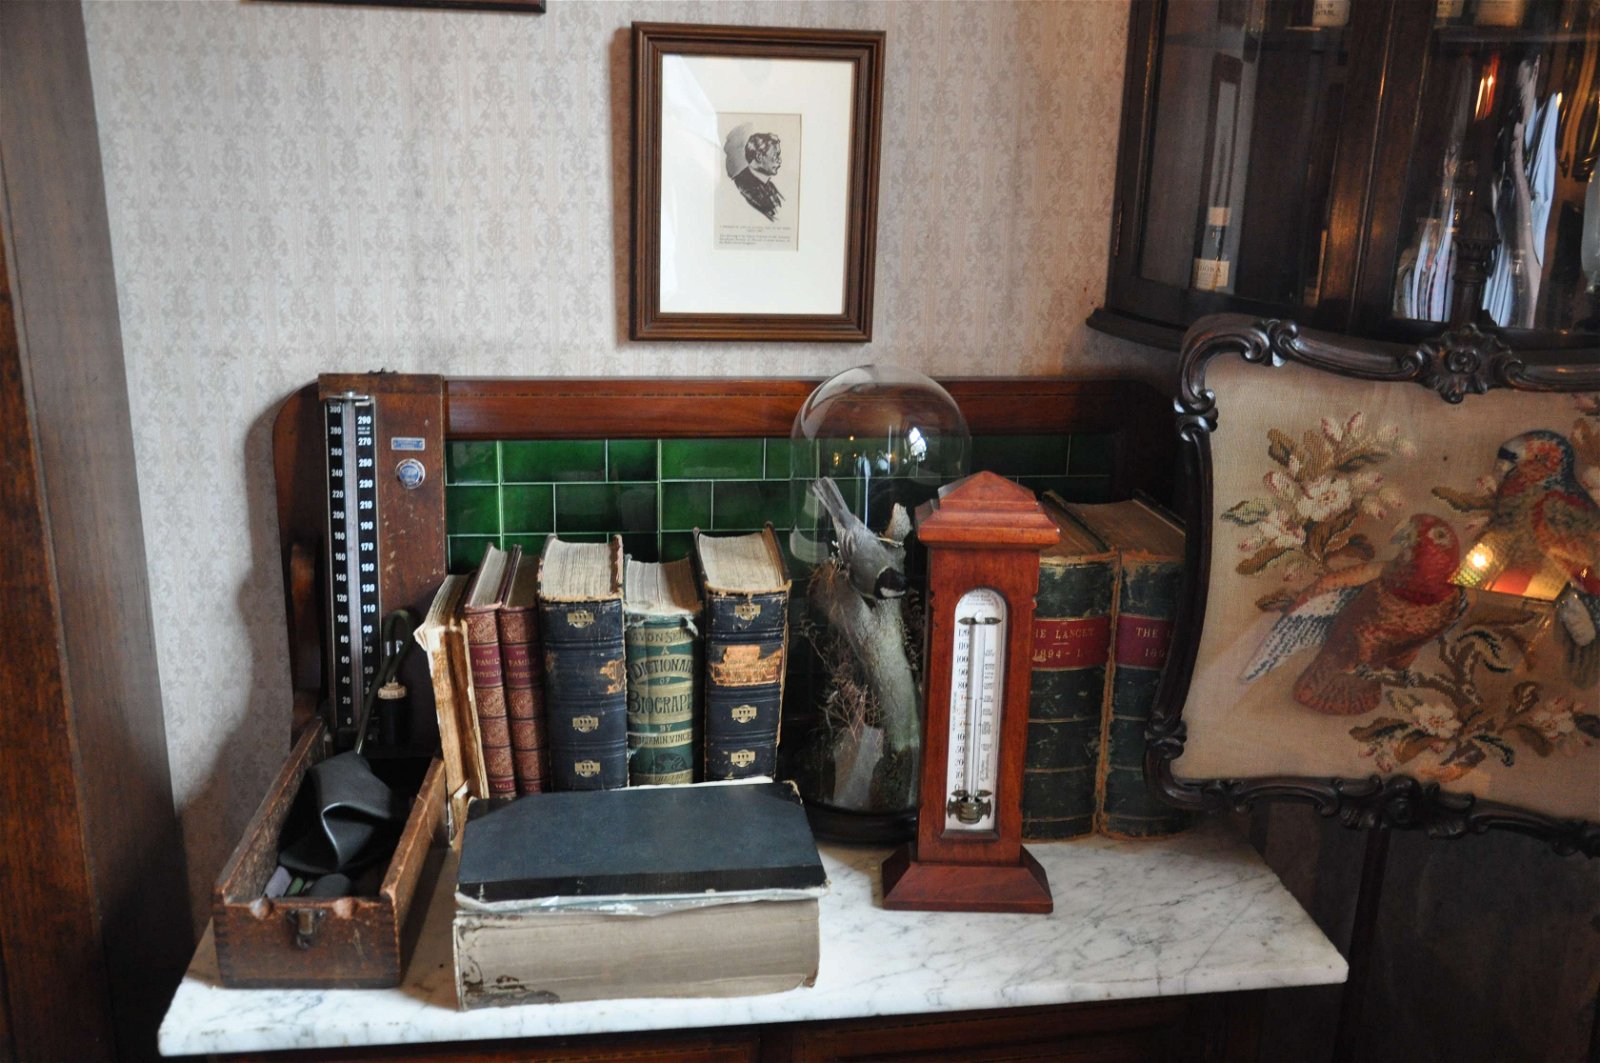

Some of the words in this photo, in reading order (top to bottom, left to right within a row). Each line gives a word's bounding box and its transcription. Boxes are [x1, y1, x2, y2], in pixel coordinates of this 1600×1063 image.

[358, 416, 371, 424] 290
[358, 437, 371, 446] 270
[332, 469, 343, 477] 240
[359, 480, 373, 488] 230
[332, 490, 344, 498] 220
[360, 501, 372, 509] 210
[332, 511, 344, 519] 200
[360, 522, 373, 530] 190
[334, 532, 345, 540] 180
[361, 543, 373, 551] 170
[335, 553, 346, 561] 160
[362, 563, 374, 572] 150
[362, 584, 375, 592] 130
[363, 604, 375, 613] 110
[338, 615, 348, 623] 100
[363, 625, 372, 634] 90
[1055, 627, 1094, 640] LANCET
[1136, 627, 1158, 638] THE
[631, 658, 692, 679] DICTIONAR
[627, 690, 692, 714] BIOGRAP
[660, 724, 672, 732] BY
